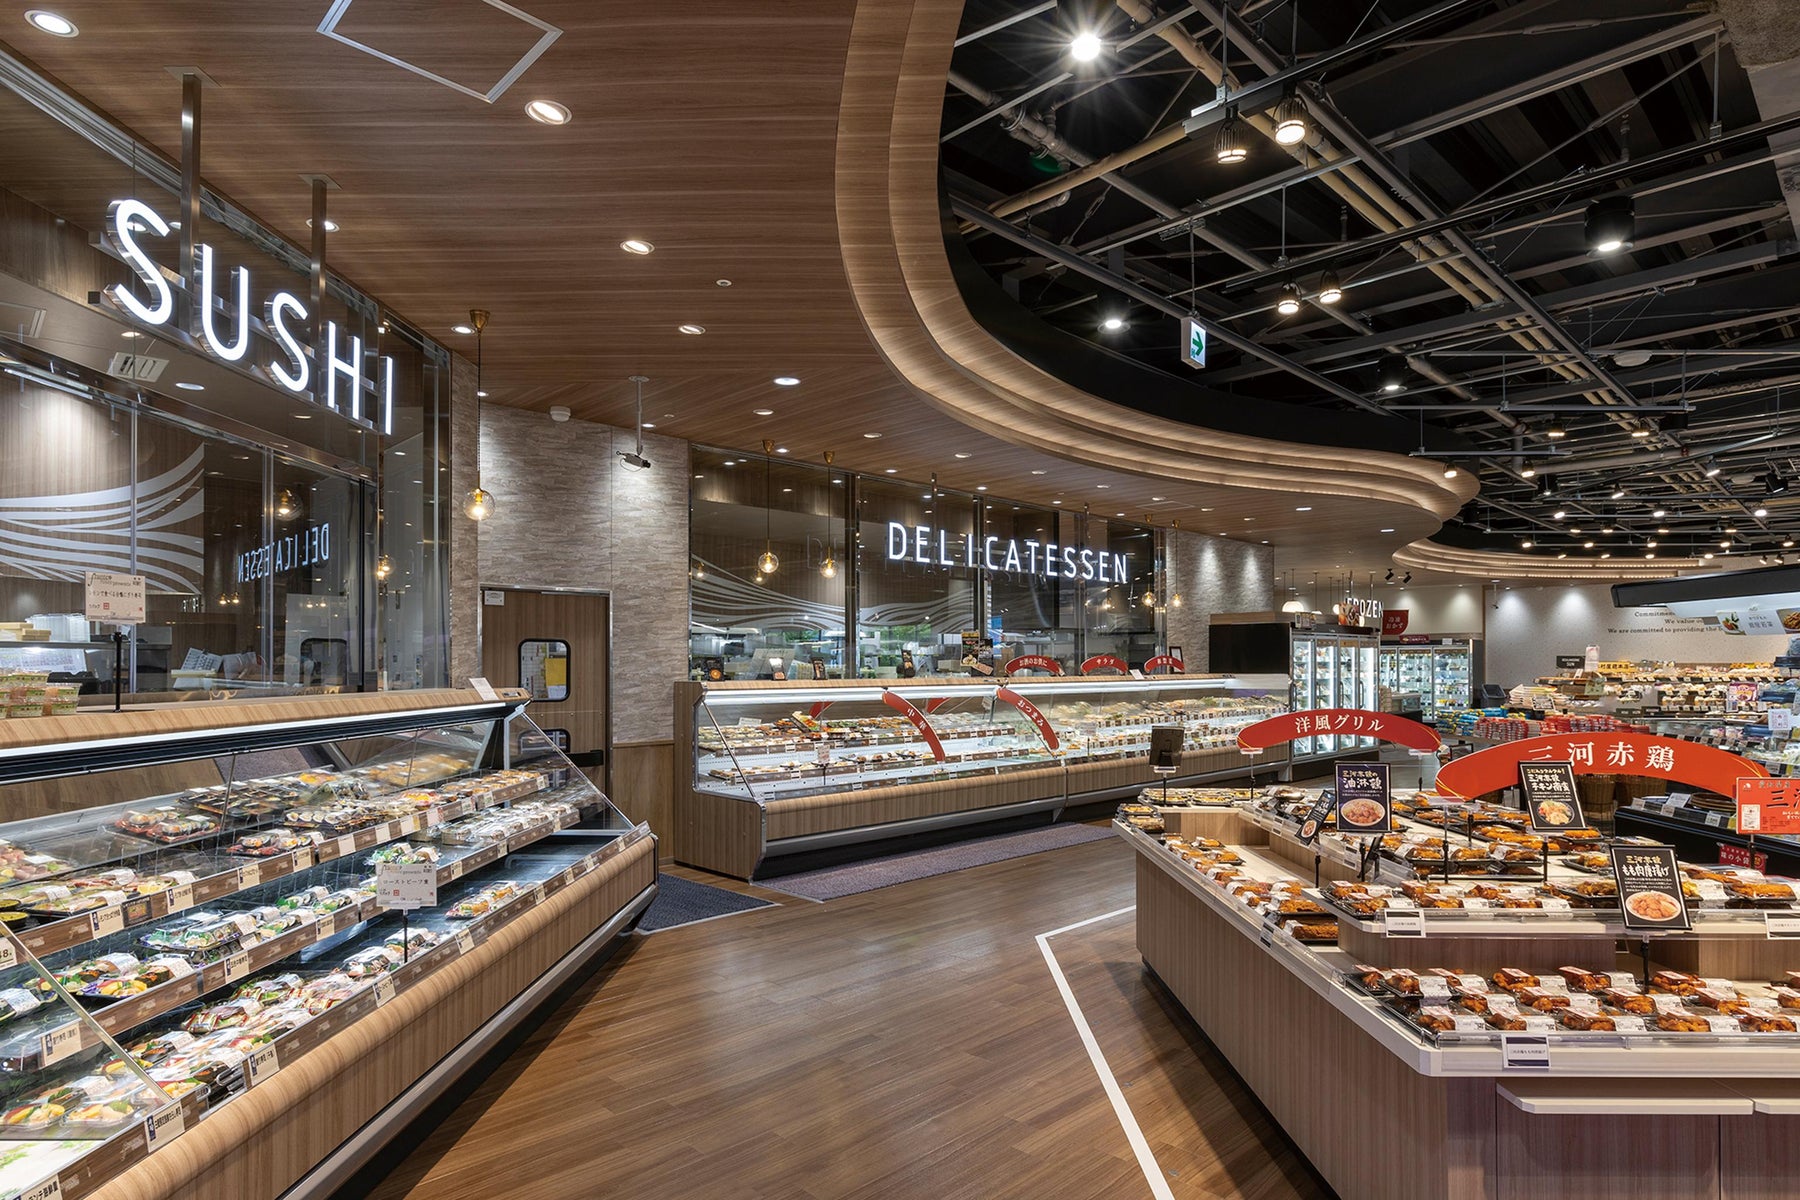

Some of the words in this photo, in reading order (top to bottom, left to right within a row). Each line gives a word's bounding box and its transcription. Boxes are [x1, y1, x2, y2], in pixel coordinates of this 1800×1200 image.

[104, 199, 393, 435] SUSHI
[888, 522, 1128, 584] DELICATESSEN
[1096, 657, 1115, 665] サラダ
[1017, 699, 1044, 727] おつまみ
[1294, 713, 1385, 734] 洋風グリル
[1527, 741, 1675, 772] 三河赤鶏
